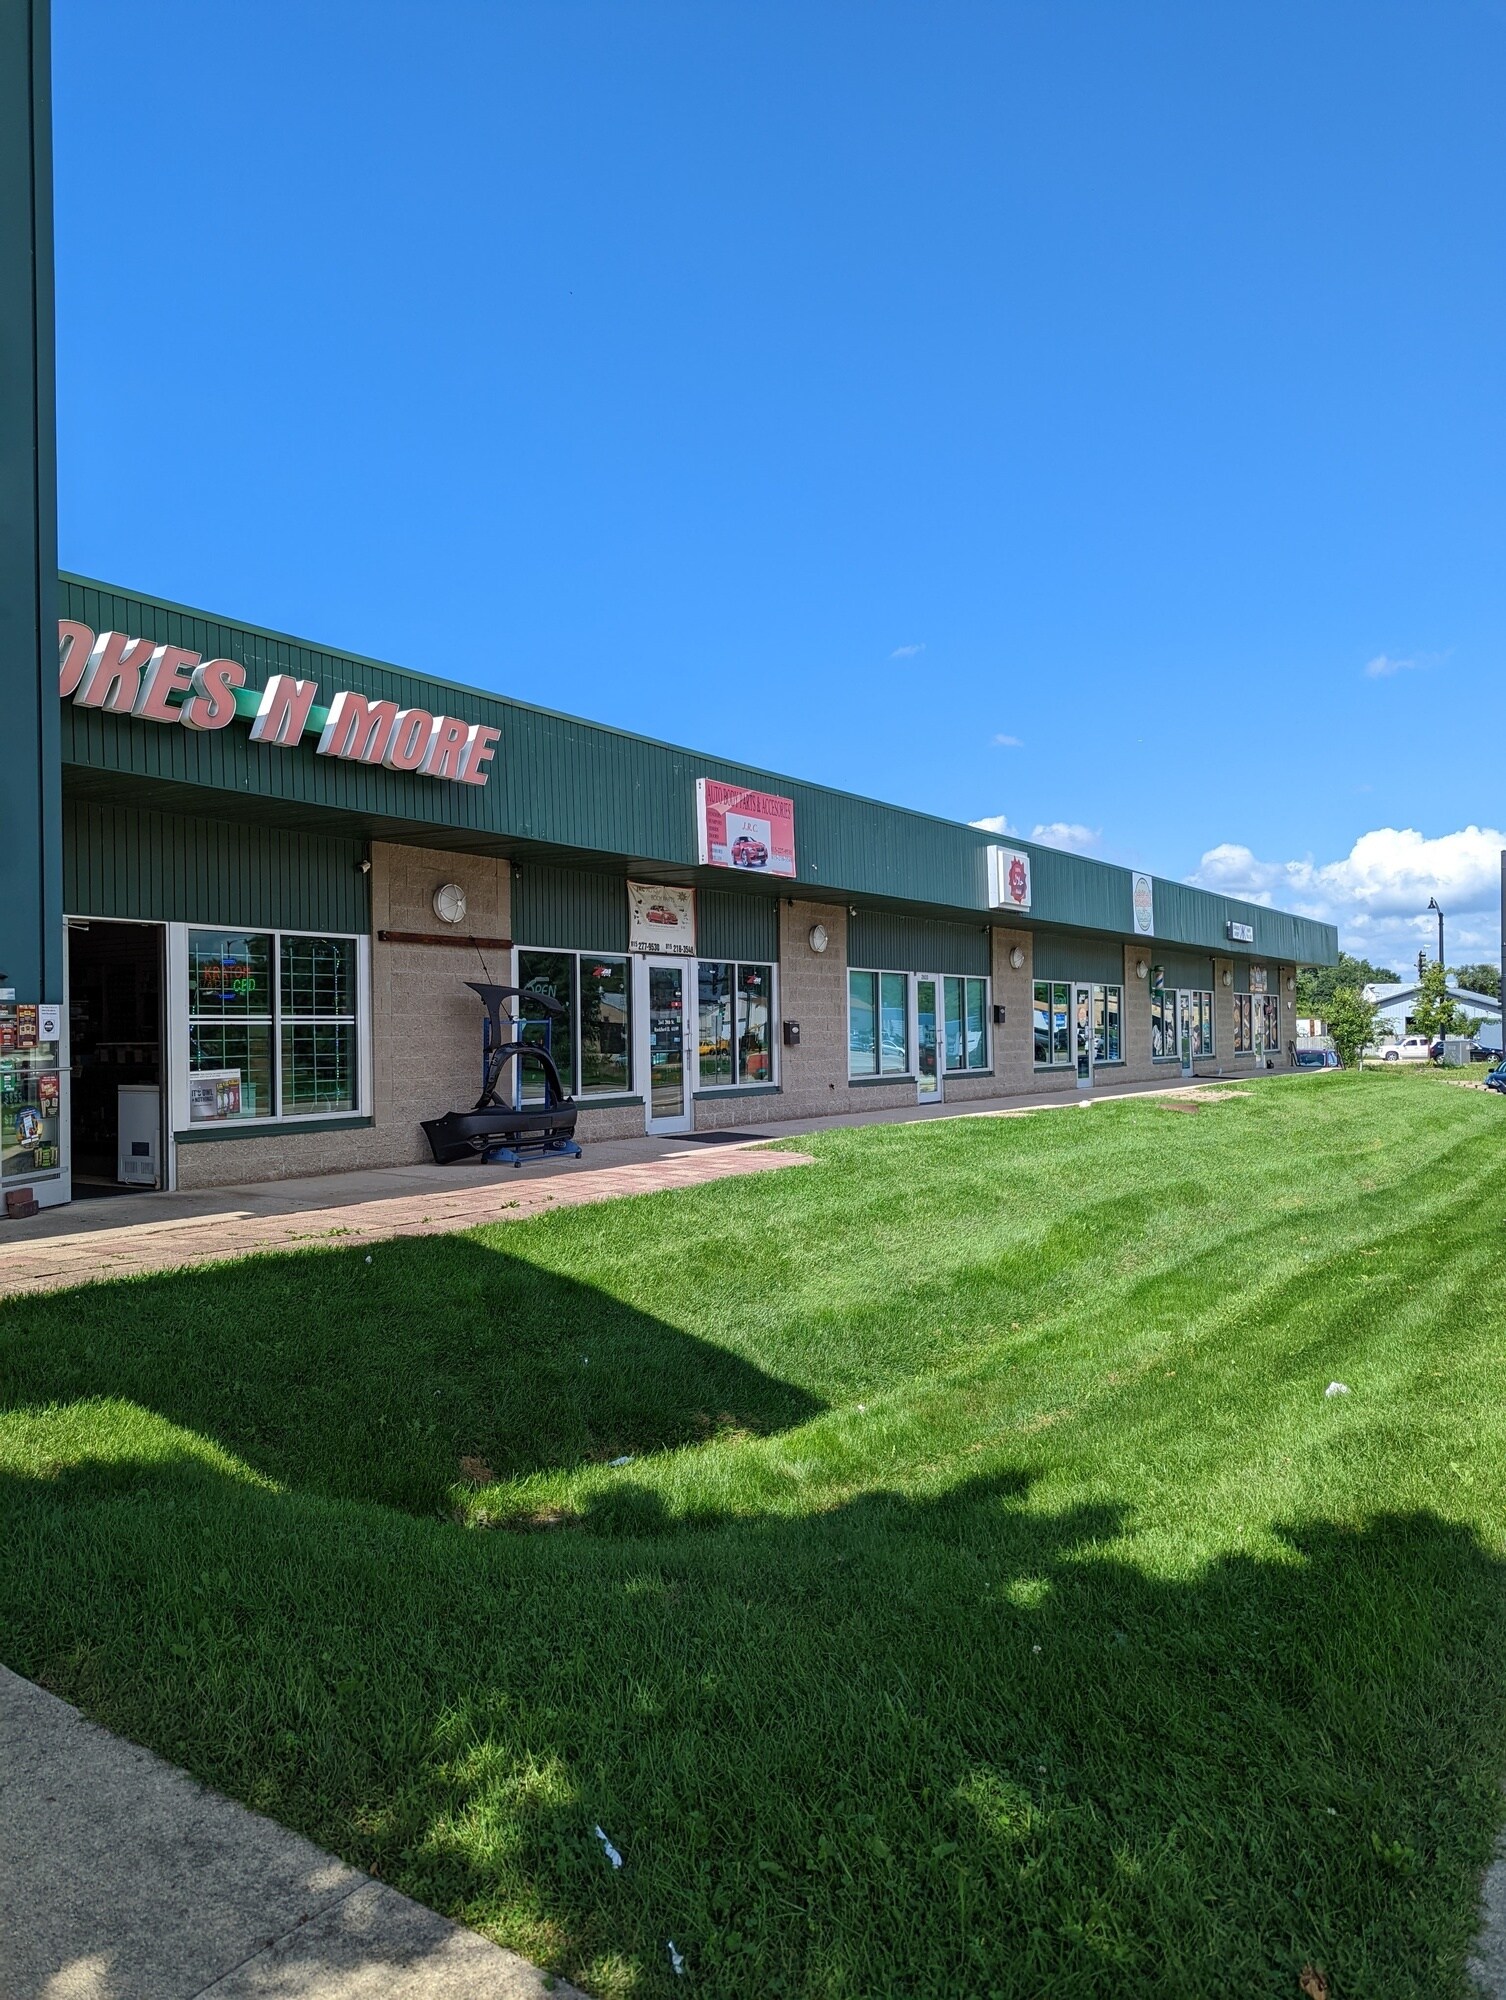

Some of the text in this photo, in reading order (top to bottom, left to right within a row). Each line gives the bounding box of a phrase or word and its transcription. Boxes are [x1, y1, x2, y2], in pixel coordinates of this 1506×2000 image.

[249, 674, 318, 748] N
[316, 691, 501, 786] MORE
[707, 784, 723, 804] AUTO
[723, 788, 739, 808] BODY
[739, 792, 756, 812] PARTS
